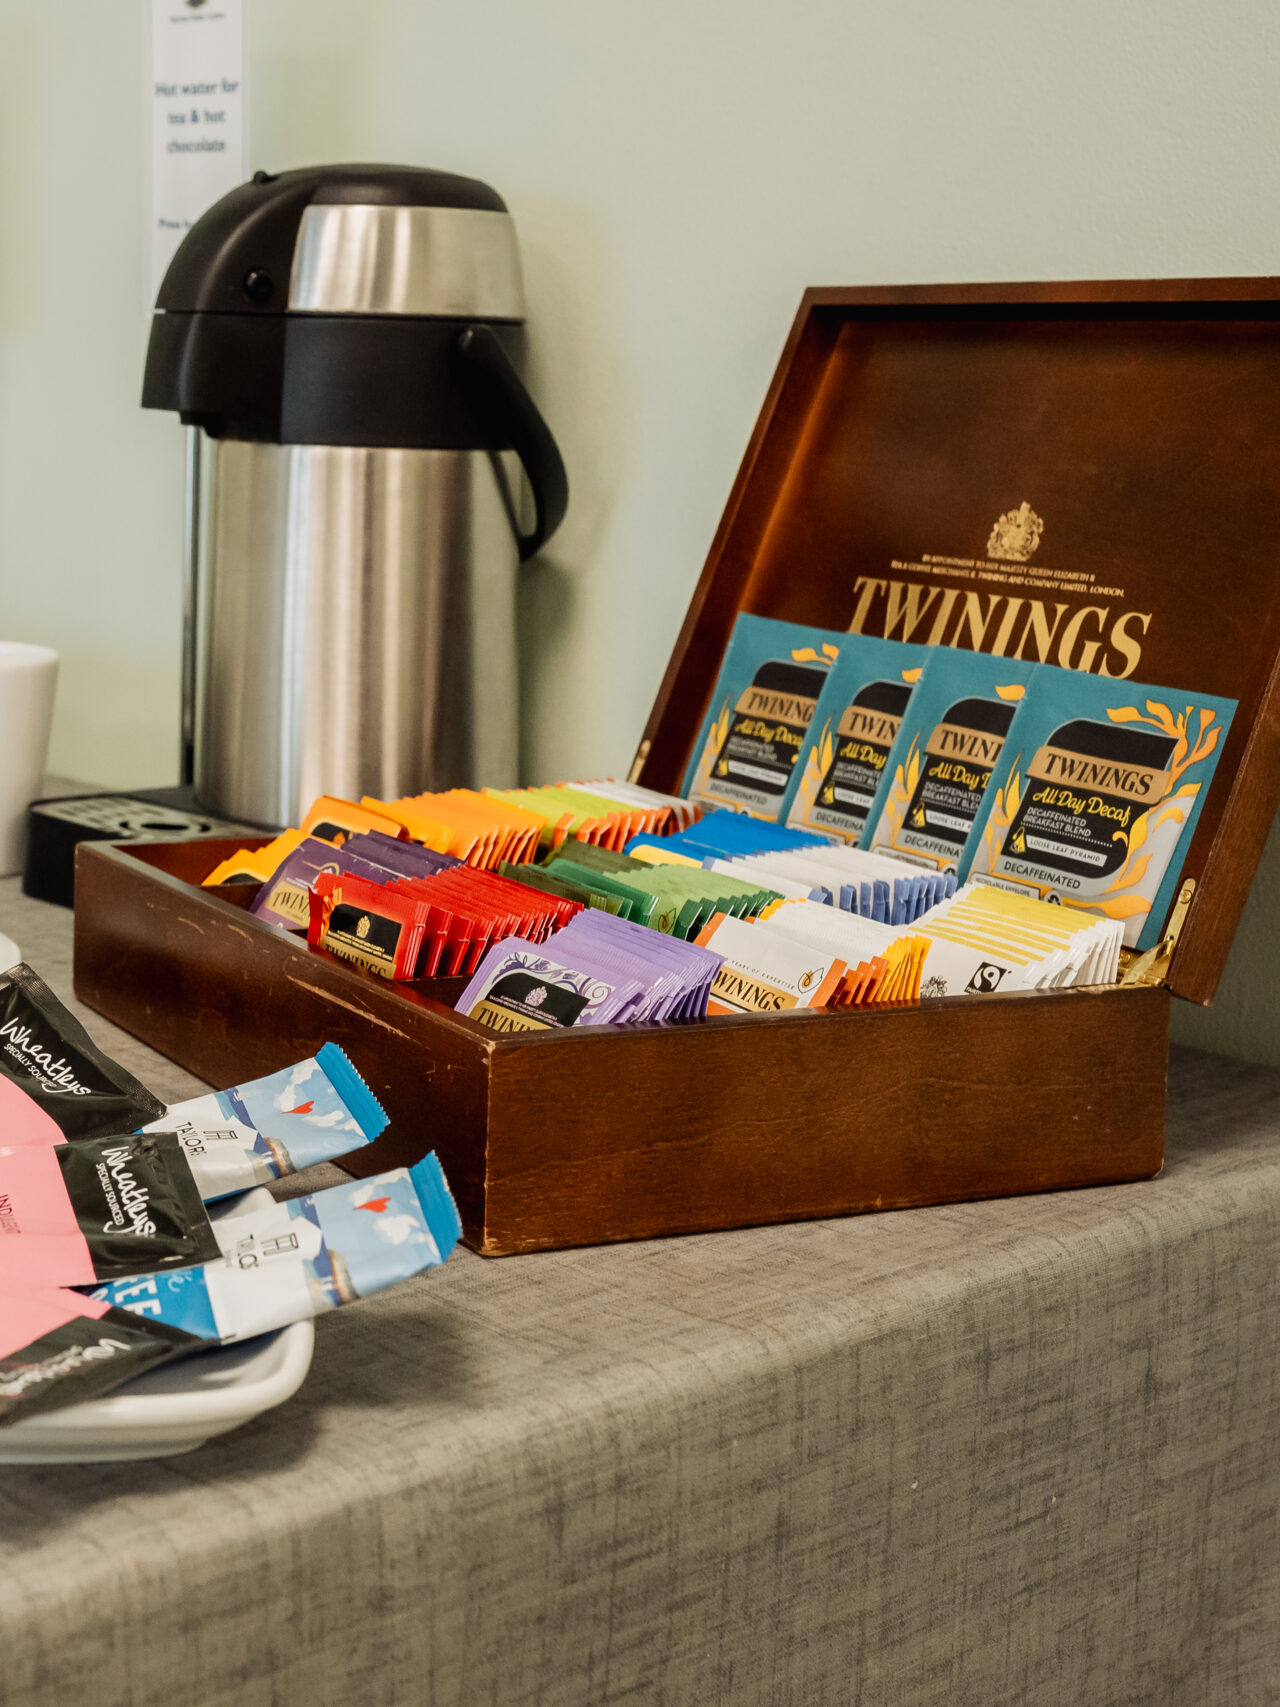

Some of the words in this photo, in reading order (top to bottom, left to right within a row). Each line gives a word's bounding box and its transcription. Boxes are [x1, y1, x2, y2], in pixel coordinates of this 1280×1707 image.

[155, 82, 177, 96] Hot
[181, 81, 217, 95] water
[220, 77, 238, 94] for
[204, 109, 225, 122] hot
[167, 139, 225, 152] chocolate
[847, 576, 1153, 680] TWININGS
[775, 725, 803, 751] Deca
[849, 711, 901, 741] TWIN
[840, 741, 859, 759] All
[860, 744, 888, 770] Day
[941, 729, 1004, 763] TWINI
[929, 761, 951, 780] All
[953, 765, 980, 790] Day
[981, 771, 992, 789] D
[1045, 752, 1154, 797] TWININGS
[921, 790, 961, 806] BREAKFAST
[961, 799, 981, 811] BLEN
[1032, 787, 1057, 804] All
[1058, 790, 1086, 815] Day
[1088, 796, 1132, 828] Decaf
[815, 811, 864, 833] DECAFFEINA
[1022, 815, 1066, 833] BREAKFAST
[1064, 822, 1092, 838] BLEND
[1026, 806, 1087, 828] DECAFFEINATED
[904, 833, 961, 858] DECAFFEINA
[1030, 838, 1050, 849] LOOSE
[1052, 843, 1067, 855] LEAF
[1069, 847, 1101, 862] PYRAMID
[1003, 860, 1081, 890] DECAFFEINATED
[731, 959, 750, 971] YEARS
[761, 972, 795, 990] EXPERTISE
[712, 969, 786, 1012] WININGS
[0, 1016, 92, 1095] Wheatleys
[3, 1043, 33, 1067] SPECIALLY
[95, 1163, 111, 1195] SPECIALLY
[105, 1192, 125, 1226] SOURCED
[101, 1146, 157, 1237] Wheatleys
